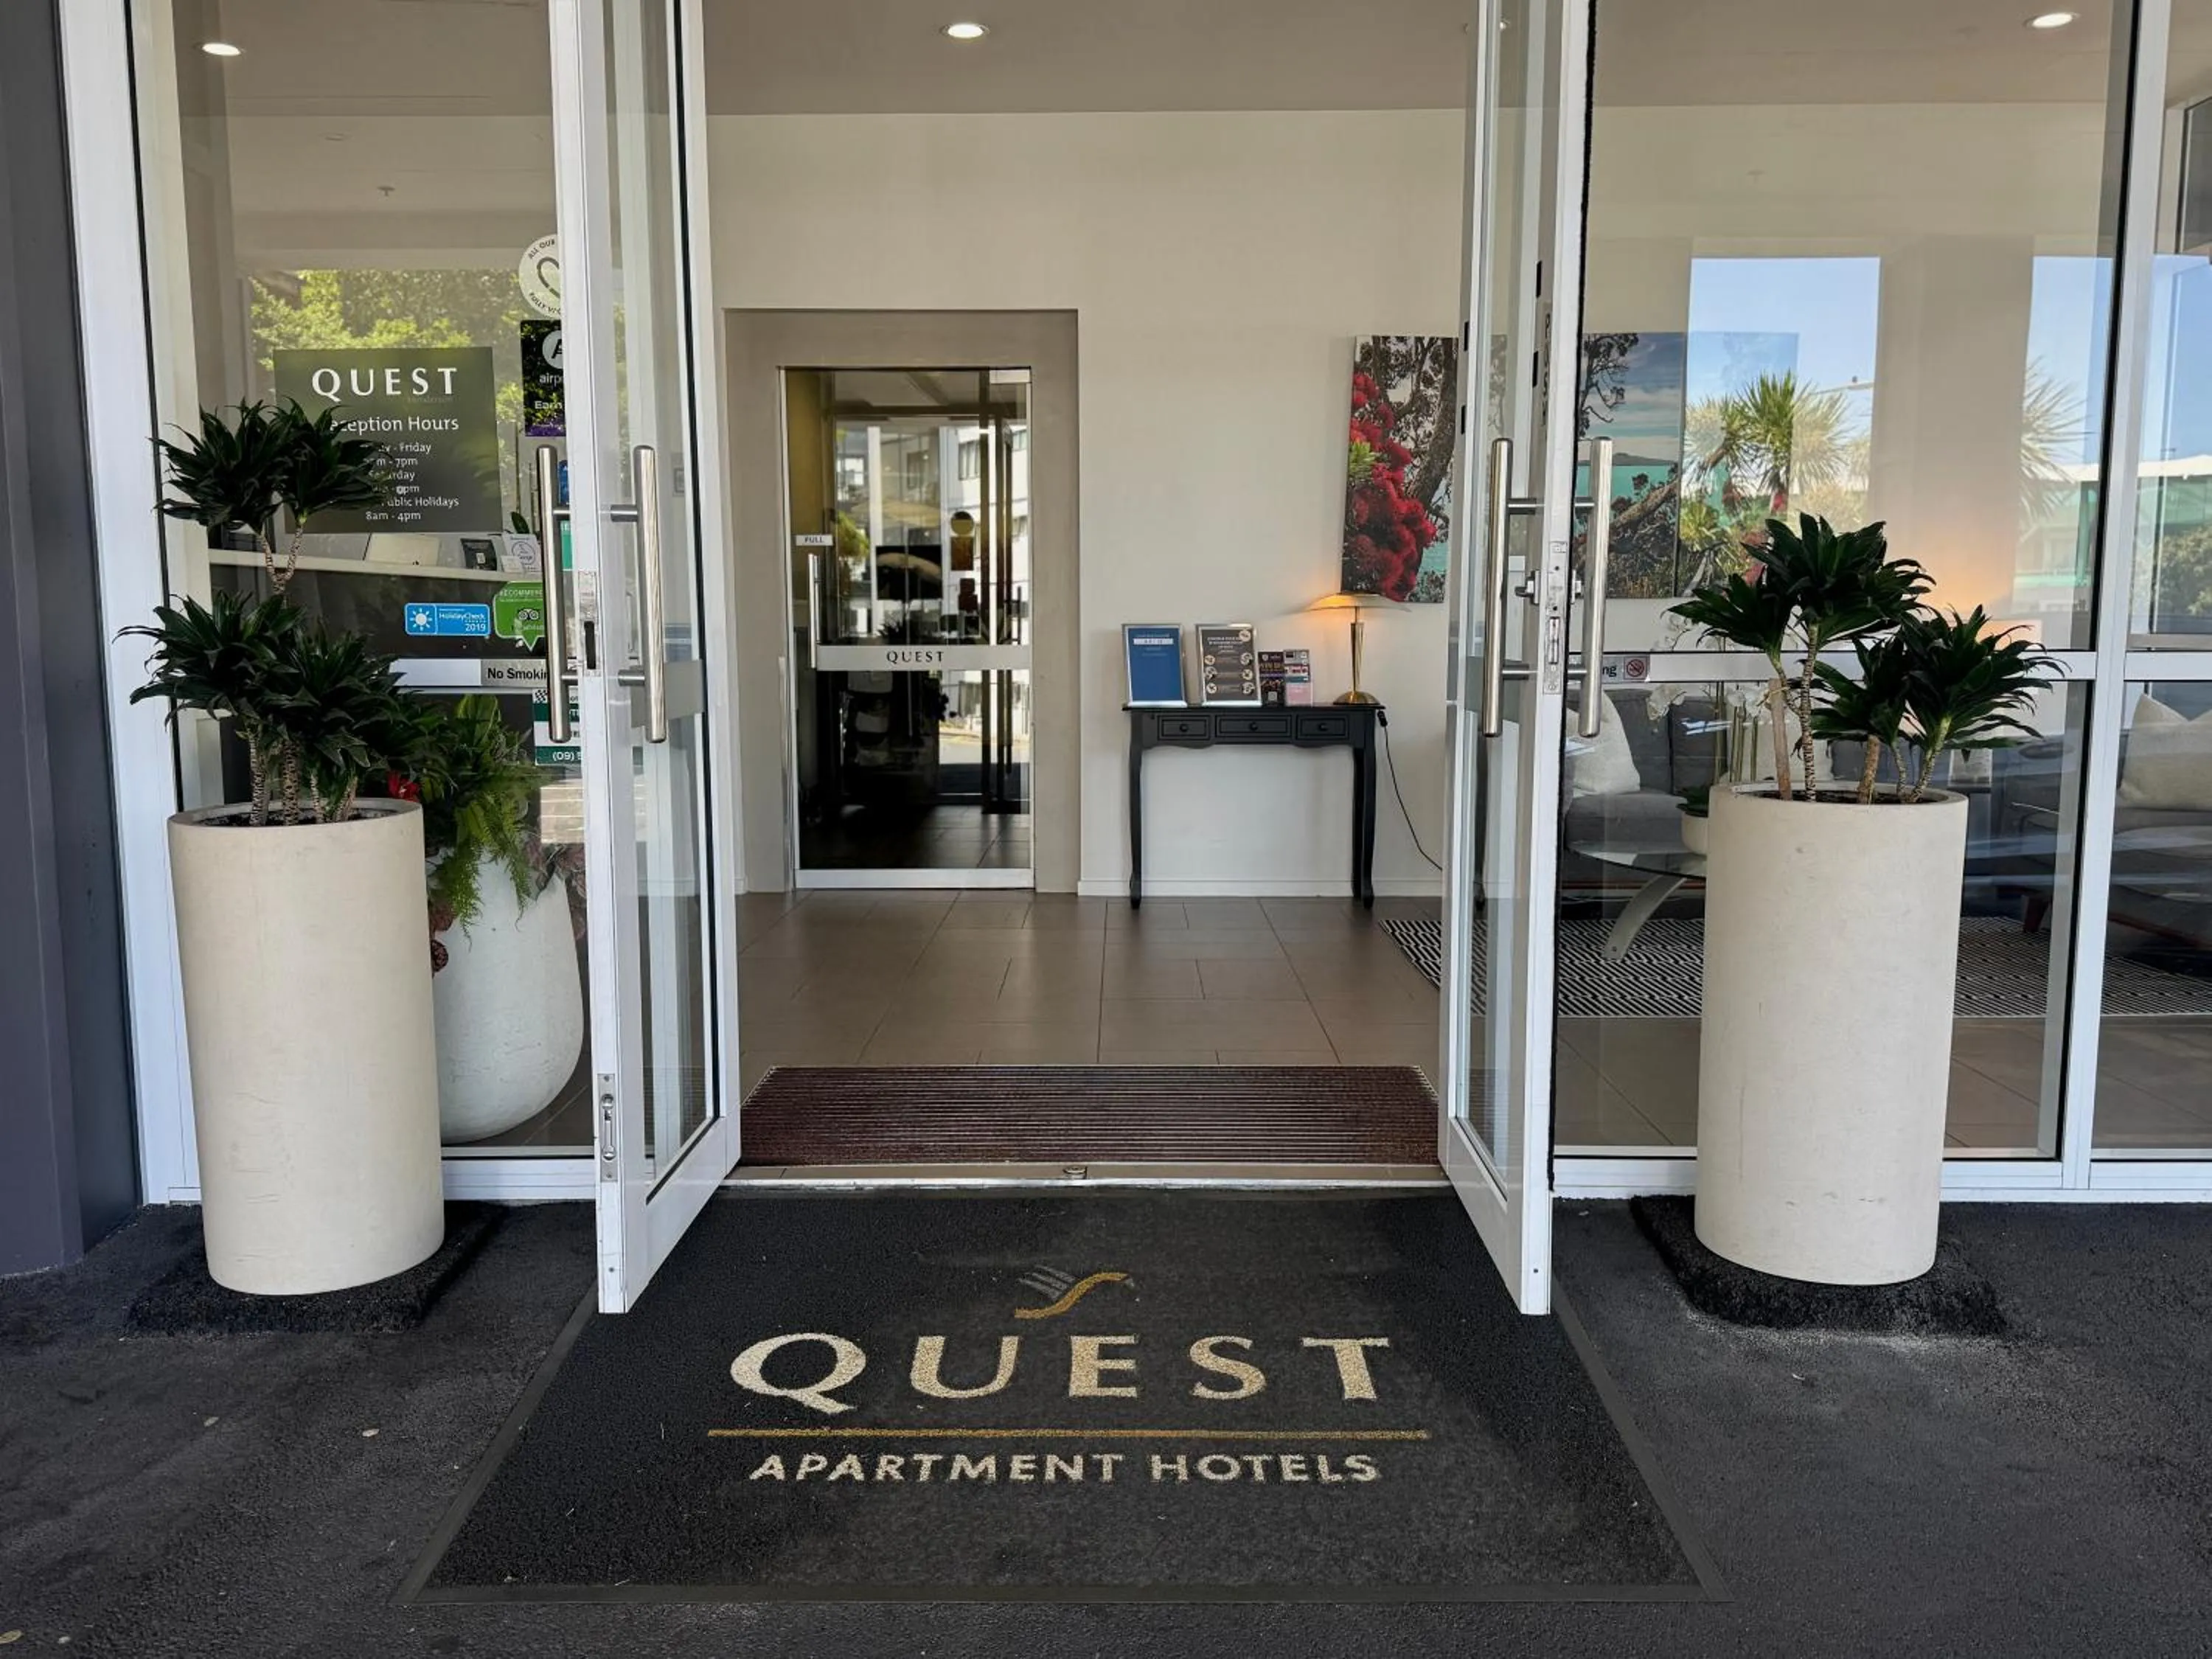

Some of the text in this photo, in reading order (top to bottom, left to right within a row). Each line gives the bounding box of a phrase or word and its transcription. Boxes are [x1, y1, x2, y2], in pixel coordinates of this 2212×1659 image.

[311, 367, 458, 403] QUEST
[330, 416, 459, 436] eception Hours
[399, 442, 431, 455] Friday
[395, 458, 418, 468] 7pm
[382, 495, 460, 509] ublic Holidays
[365, 511, 389, 521] 8am
[397, 512, 421, 523] 4pm
[465, 623, 486, 632] 2019
[886, 651, 944, 664] QUEST
[487, 668, 504, 679] No
[553, 751, 574, 762] (09)
[730, 1332, 1390, 1414] QUEST
[748, 1453, 1382, 1483] APARTMENT HOTELS
